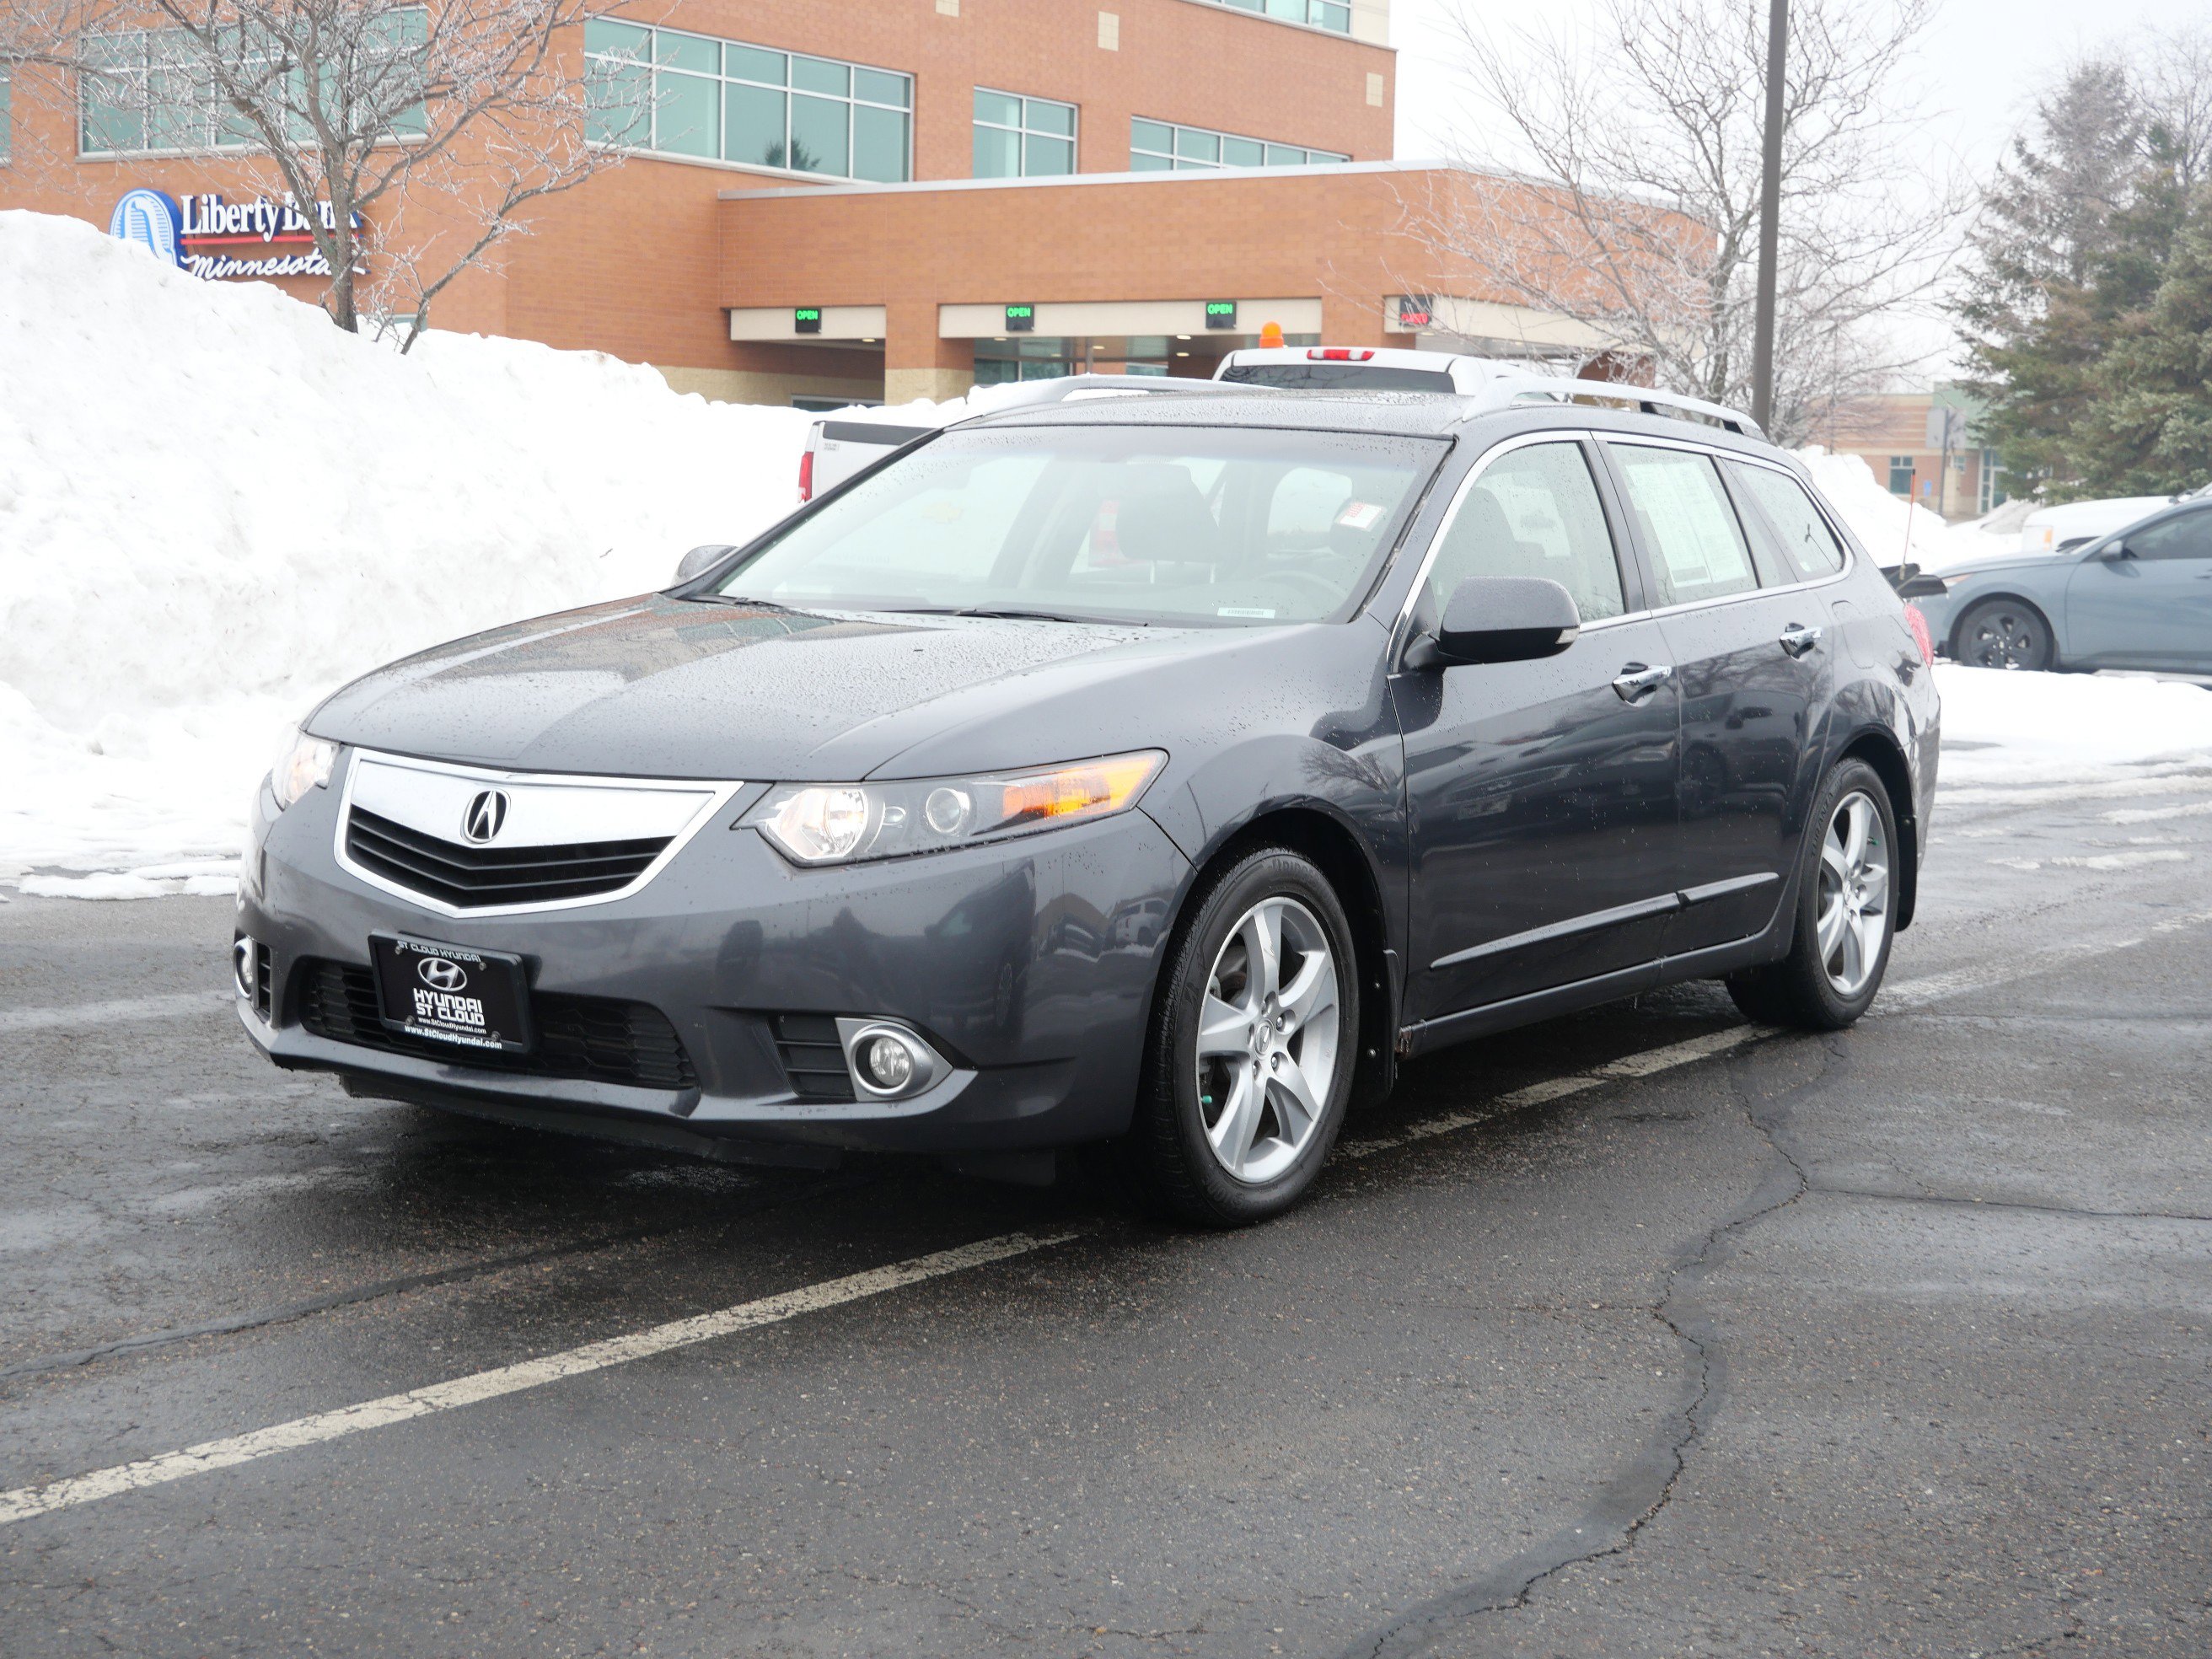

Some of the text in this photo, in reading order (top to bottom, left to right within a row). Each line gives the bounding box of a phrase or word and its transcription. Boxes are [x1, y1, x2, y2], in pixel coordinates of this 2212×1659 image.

[180, 191, 357, 242] Liberty Bn
[180, 247, 366, 280] Minnesota
[797, 309, 819, 320] OPEN
[1007, 307, 1031, 318] OPEN
[1207, 303, 1233, 314] OPEN
[398, 941, 481, 962] ST CLOUD HYUNDAI
[413, 988, 483, 1013] HYUNDAI
[416, 1003, 486, 1027] ST CLOUD
[418, 1016, 487, 1035] www.StCloudHyundai.com
[404, 1024, 502, 1050] www.StCloudHyundai.com
